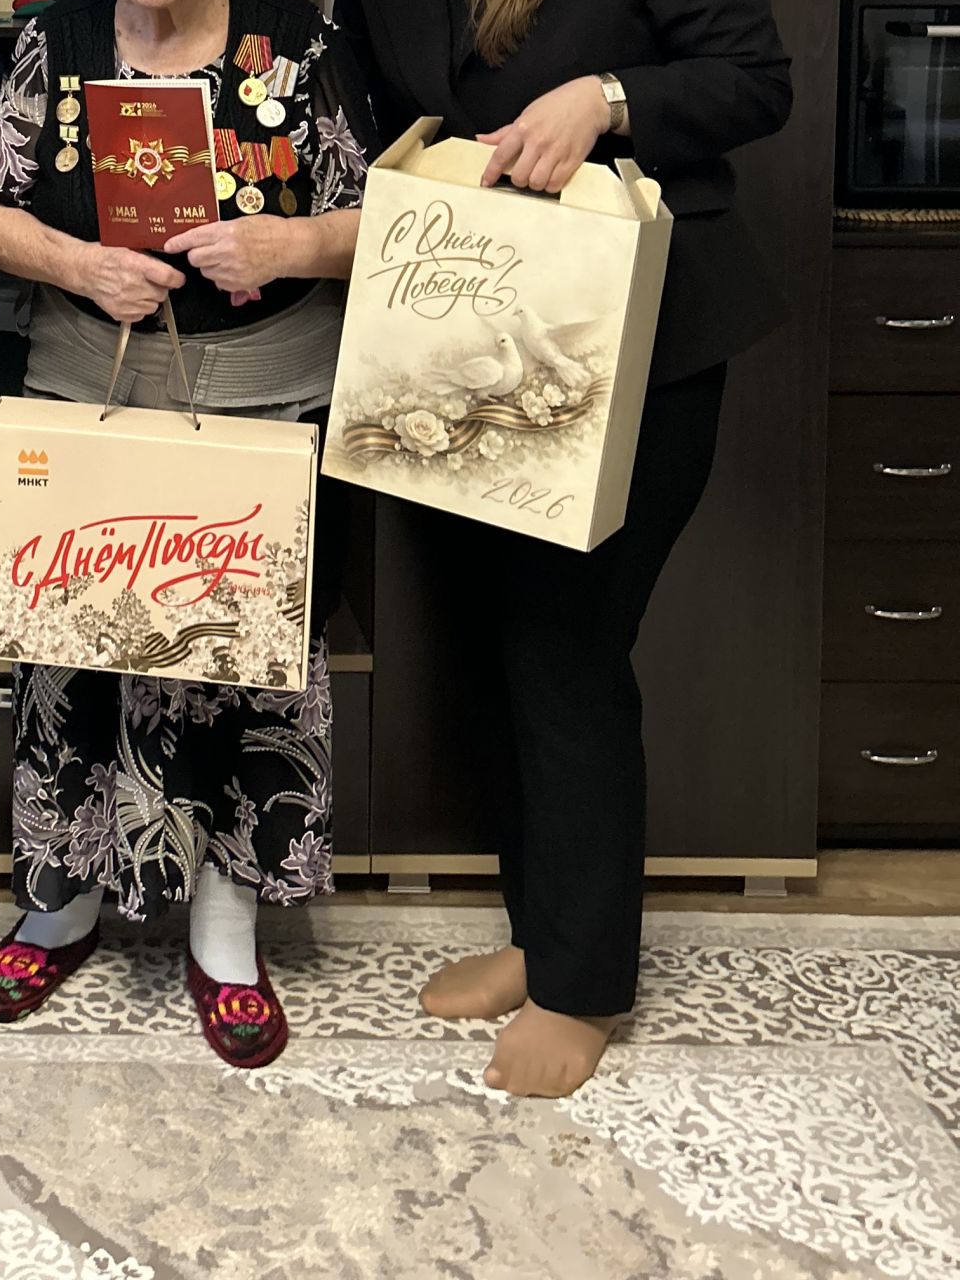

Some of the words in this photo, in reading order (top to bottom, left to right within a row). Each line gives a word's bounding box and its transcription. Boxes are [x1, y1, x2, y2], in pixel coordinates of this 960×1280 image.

[116, 206, 138, 218] МАЯ
[174, 207, 181, 218] 9
[182, 204, 206, 218] МАЙ
[150, 226, 167, 234] 1945
[380, 209, 417, 263] С
[415, 199, 516, 271] Днём
[367, 257, 523, 320] Победы!
[18, 477, 49, 487] МНКТ
[481, 478, 575, 519] 2026
[11, 535, 43, 587] С
[27, 526, 138, 610] Днём
[124, 503, 266, 608] Победы
